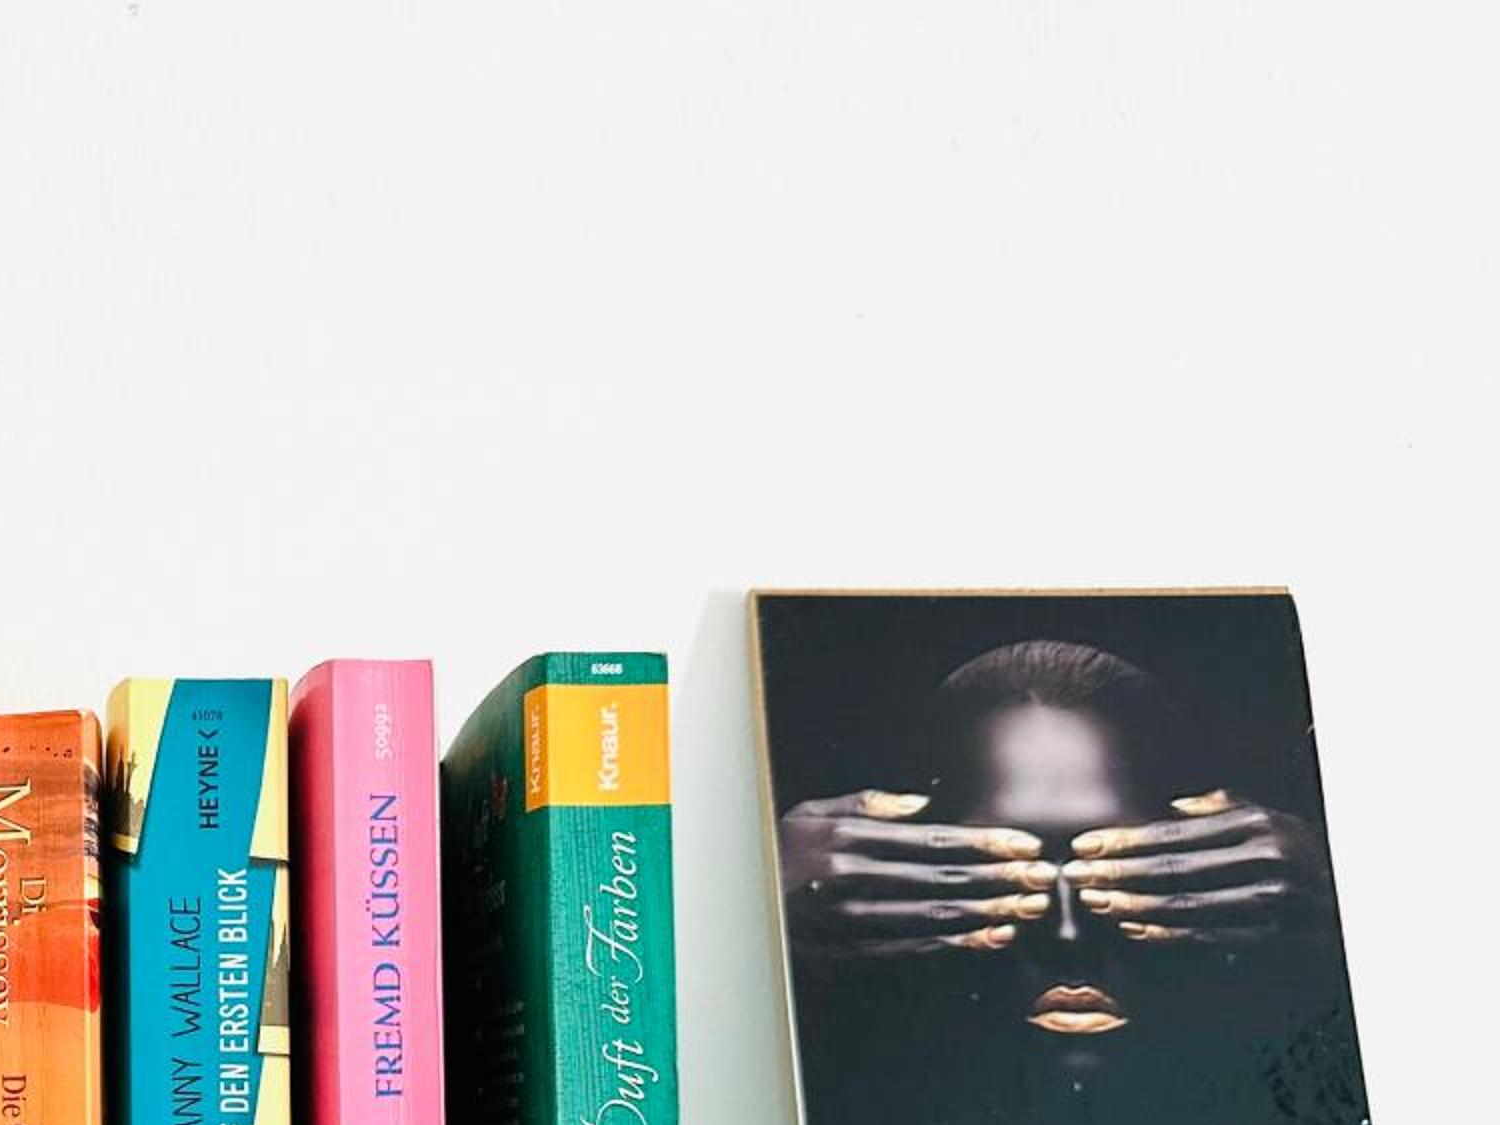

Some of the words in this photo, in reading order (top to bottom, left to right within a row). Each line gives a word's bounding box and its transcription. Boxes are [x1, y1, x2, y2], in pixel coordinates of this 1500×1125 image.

[598, 703, 619, 790] Knaur.
[217, 868, 247, 944] BLICK
[365, 794, 401, 947] KÜSSEN
[584, 831, 644, 983] Farben
[169, 896, 202, 1038] WALLACE
[218, 953, 249, 1049] ERSTEN
[599, 976, 631, 1025] der
[373, 962, 403, 1098] FREMD
[1, 1074, 27, 1118] Die
[220, 1054, 249, 1114] DEN
